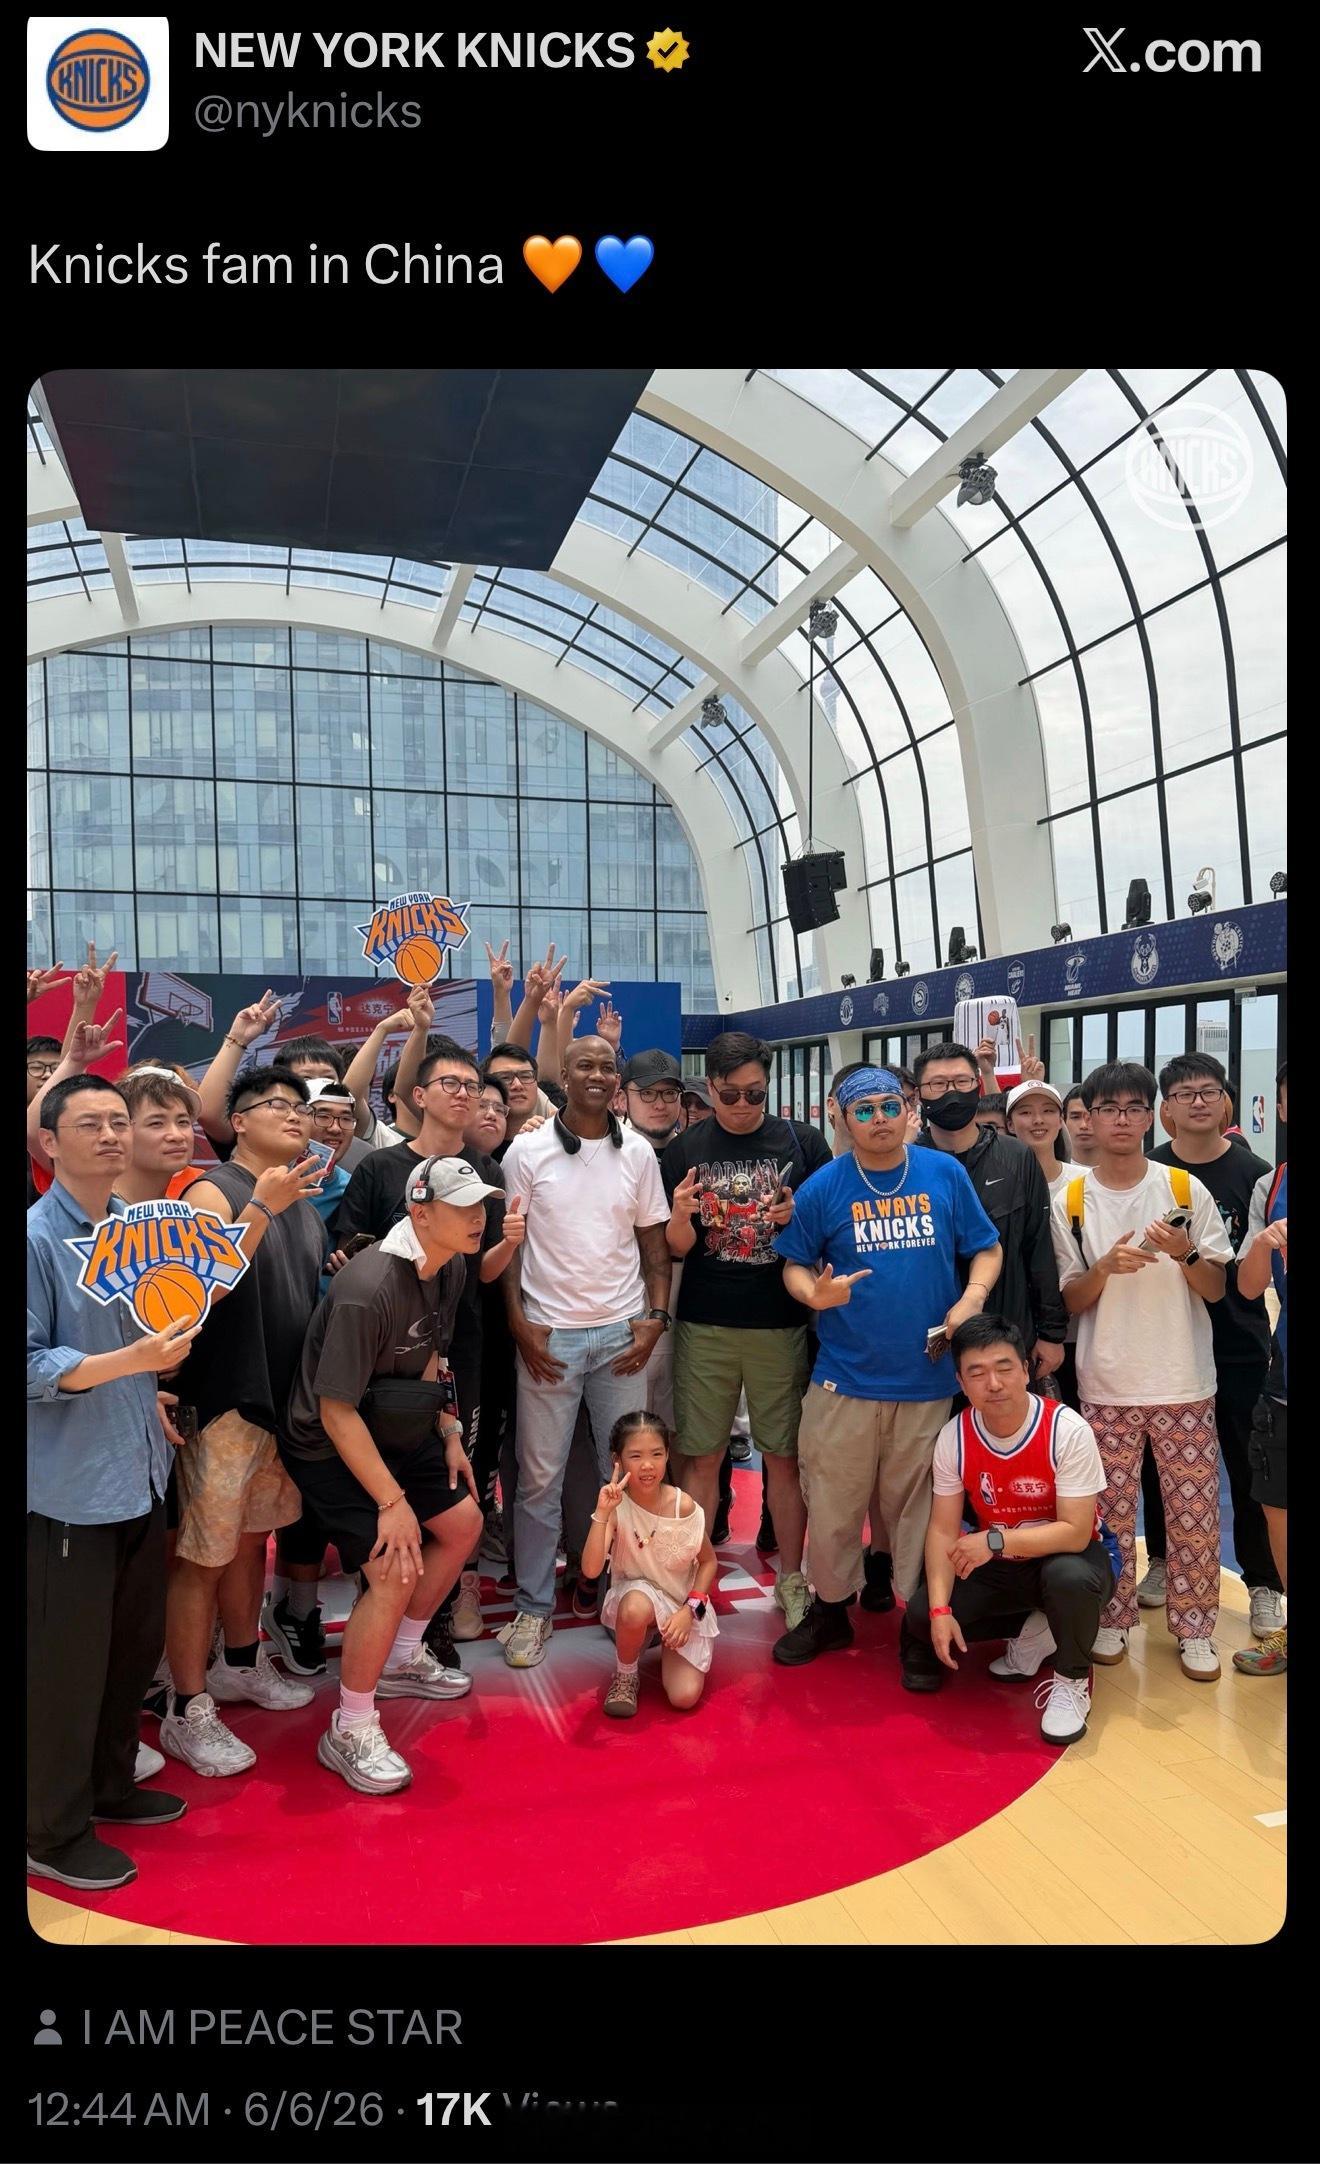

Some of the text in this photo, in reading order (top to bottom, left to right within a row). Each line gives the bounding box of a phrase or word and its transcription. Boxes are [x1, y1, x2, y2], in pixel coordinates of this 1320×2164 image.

[389, 893, 431, 911] NEW YORK
[365, 898, 467, 956] KNICKS
[127, 1202, 192, 1221] NEW YORK
[851, 1193, 931, 1221] ALWAYS
[853, 1214, 935, 1244] KNICKS
[84, 1213, 245, 1287] KNICKS
[856, 1243, 874, 1253] NEW
[901, 1237, 936, 1249] FOREVER
[1012, 1481, 1047, 1493] 达克宁
